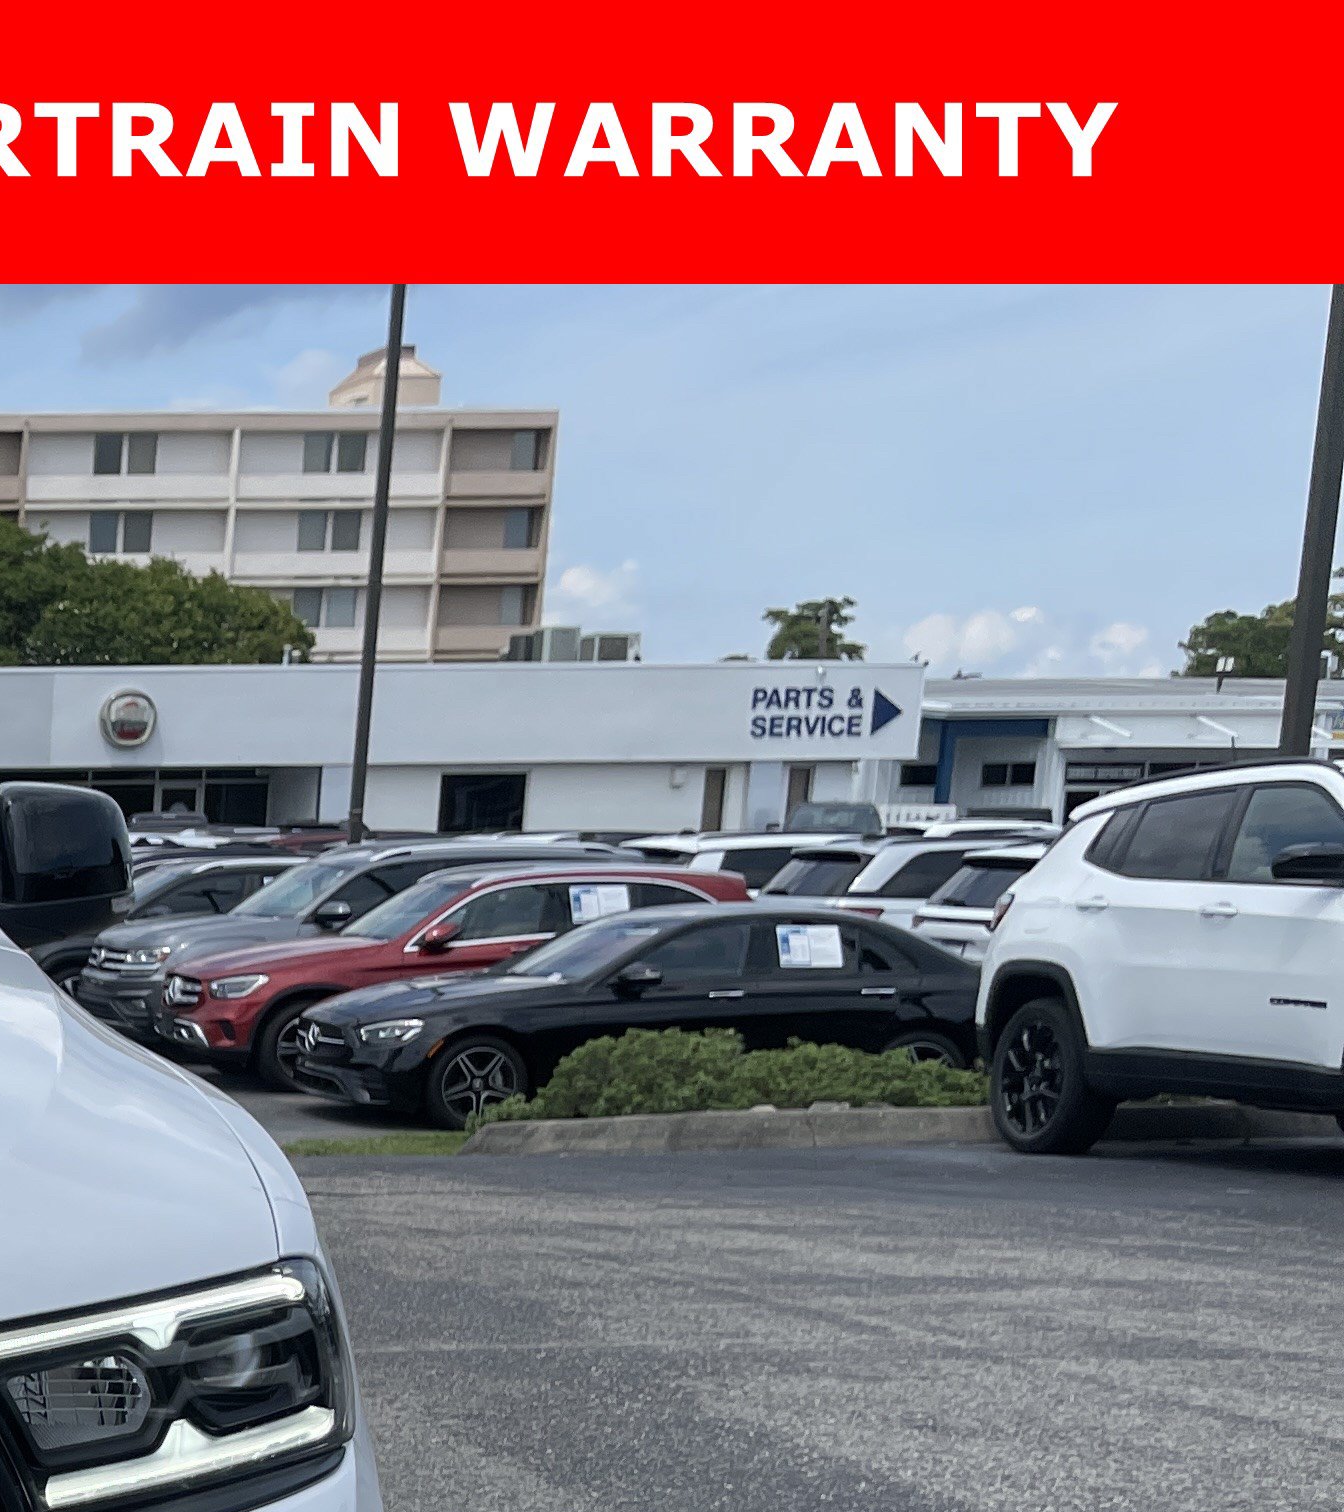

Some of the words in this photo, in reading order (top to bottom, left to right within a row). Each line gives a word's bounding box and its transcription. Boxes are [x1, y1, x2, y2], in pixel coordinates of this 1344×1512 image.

[751, 687, 834, 710] PARTS
[847, 687, 863, 710] &
[750, 714, 863, 738] SERVICE
